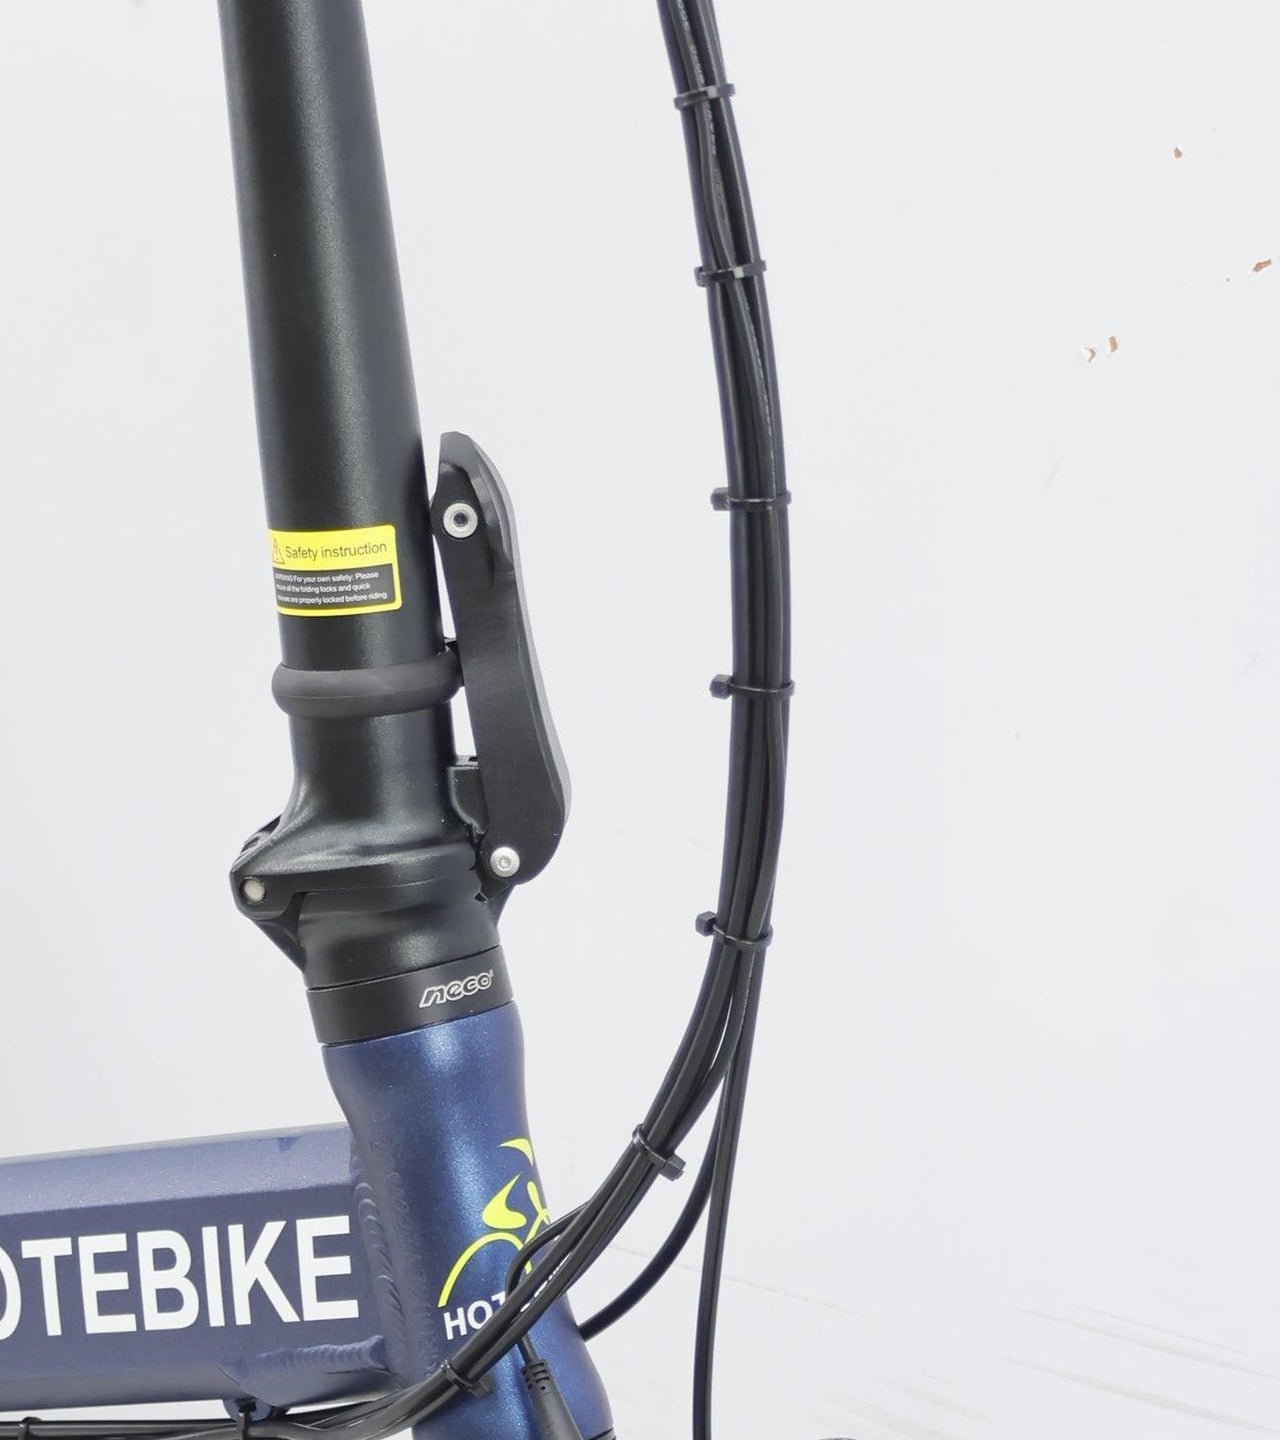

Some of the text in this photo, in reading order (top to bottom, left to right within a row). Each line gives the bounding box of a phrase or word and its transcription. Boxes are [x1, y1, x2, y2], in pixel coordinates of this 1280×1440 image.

[285, 542, 387, 561] Safety instruction
[355, 571, 380, 580] Please
[320, 583, 338, 592] locks
[338, 583, 352, 591] and
[352, 582, 371, 591] quick
[322, 594, 345, 603] locked
[345, 593, 368, 602] before
[419, 972, 492, 1008] neco
